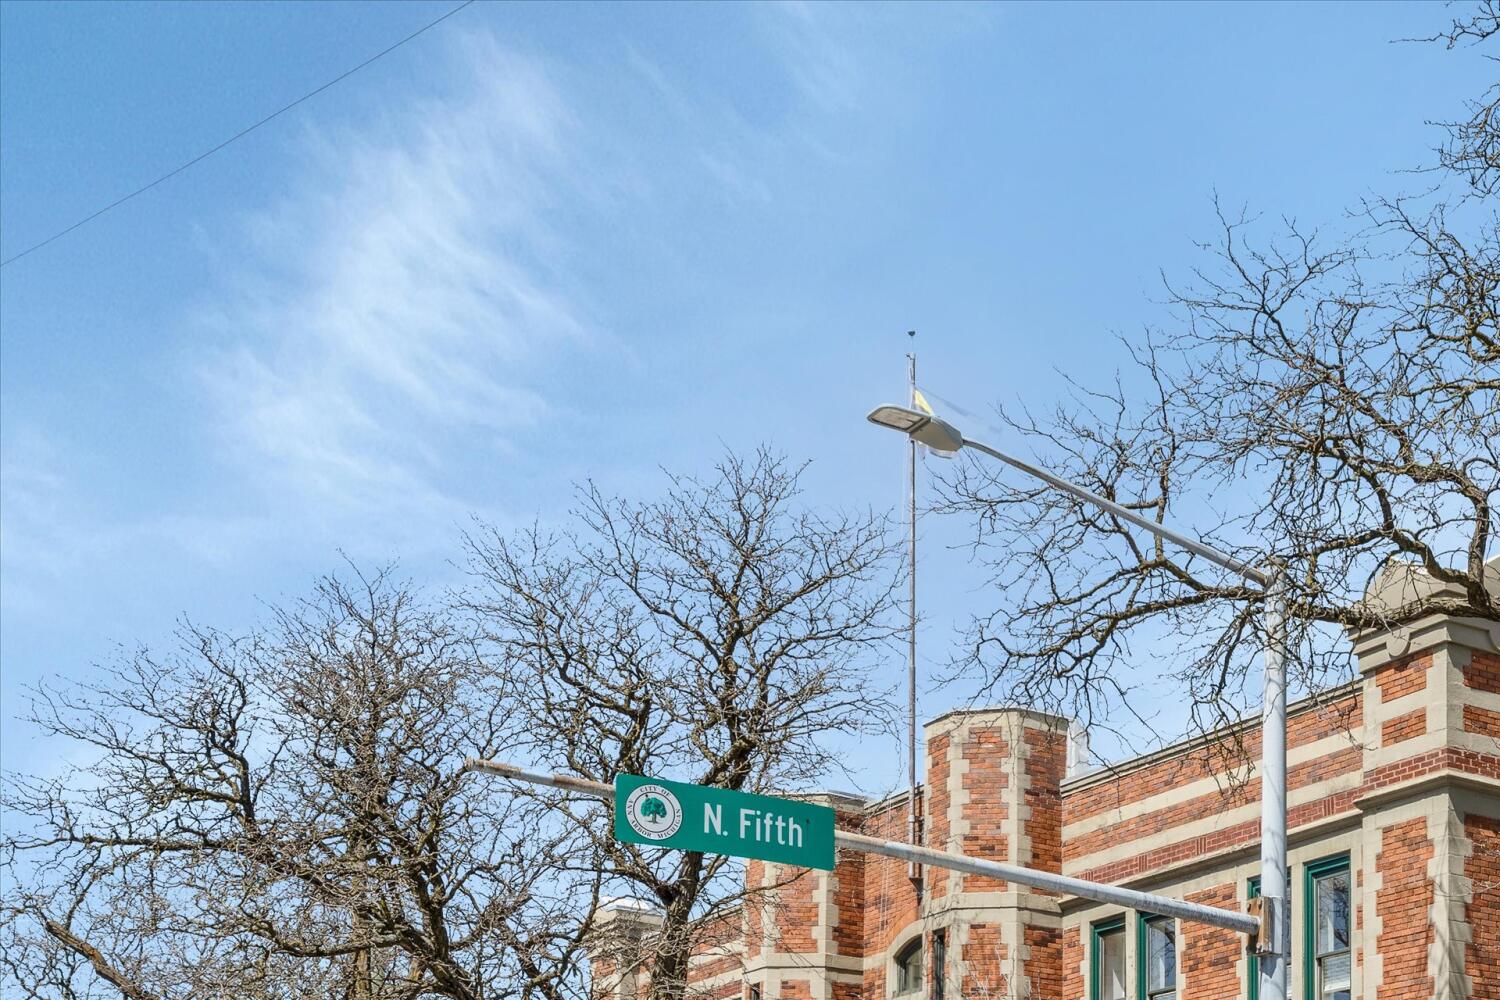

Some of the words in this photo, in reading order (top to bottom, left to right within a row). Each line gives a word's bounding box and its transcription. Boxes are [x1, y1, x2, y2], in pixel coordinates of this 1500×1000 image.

[631, 819, 652, 838] ARBOR
[657, 809, 682, 839] MICHIGAN
[704, 802, 729, 837] N.
[740, 808, 803, 848] Fifth
